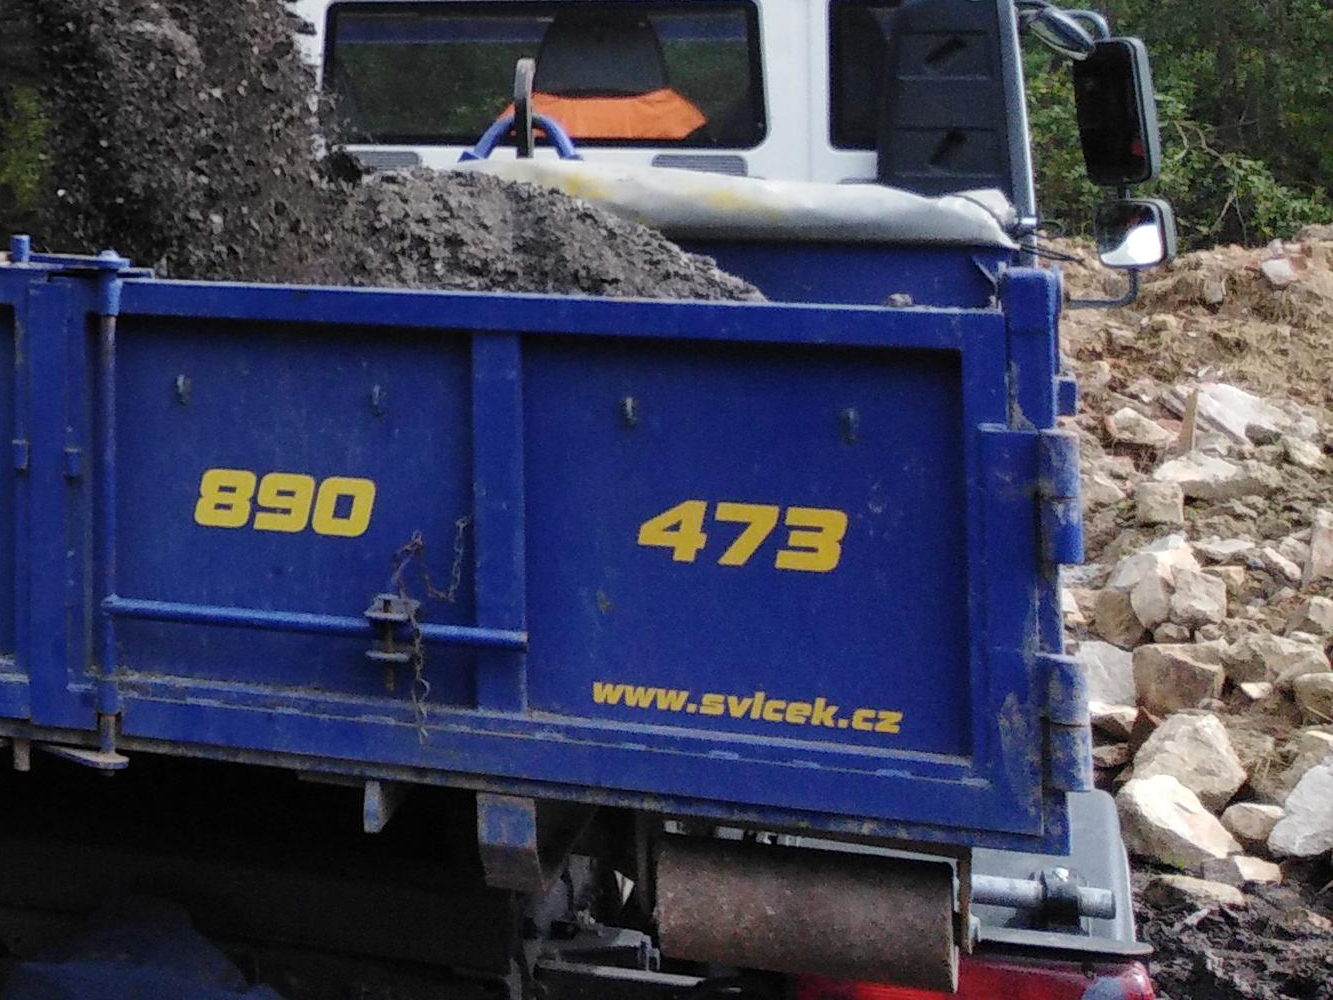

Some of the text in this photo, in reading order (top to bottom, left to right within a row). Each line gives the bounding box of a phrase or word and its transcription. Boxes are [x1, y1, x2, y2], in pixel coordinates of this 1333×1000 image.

[194, 468, 376, 538] 890
[638, 499, 848, 573] 473
[591, 680, 904, 735] www.svlcek.cz
